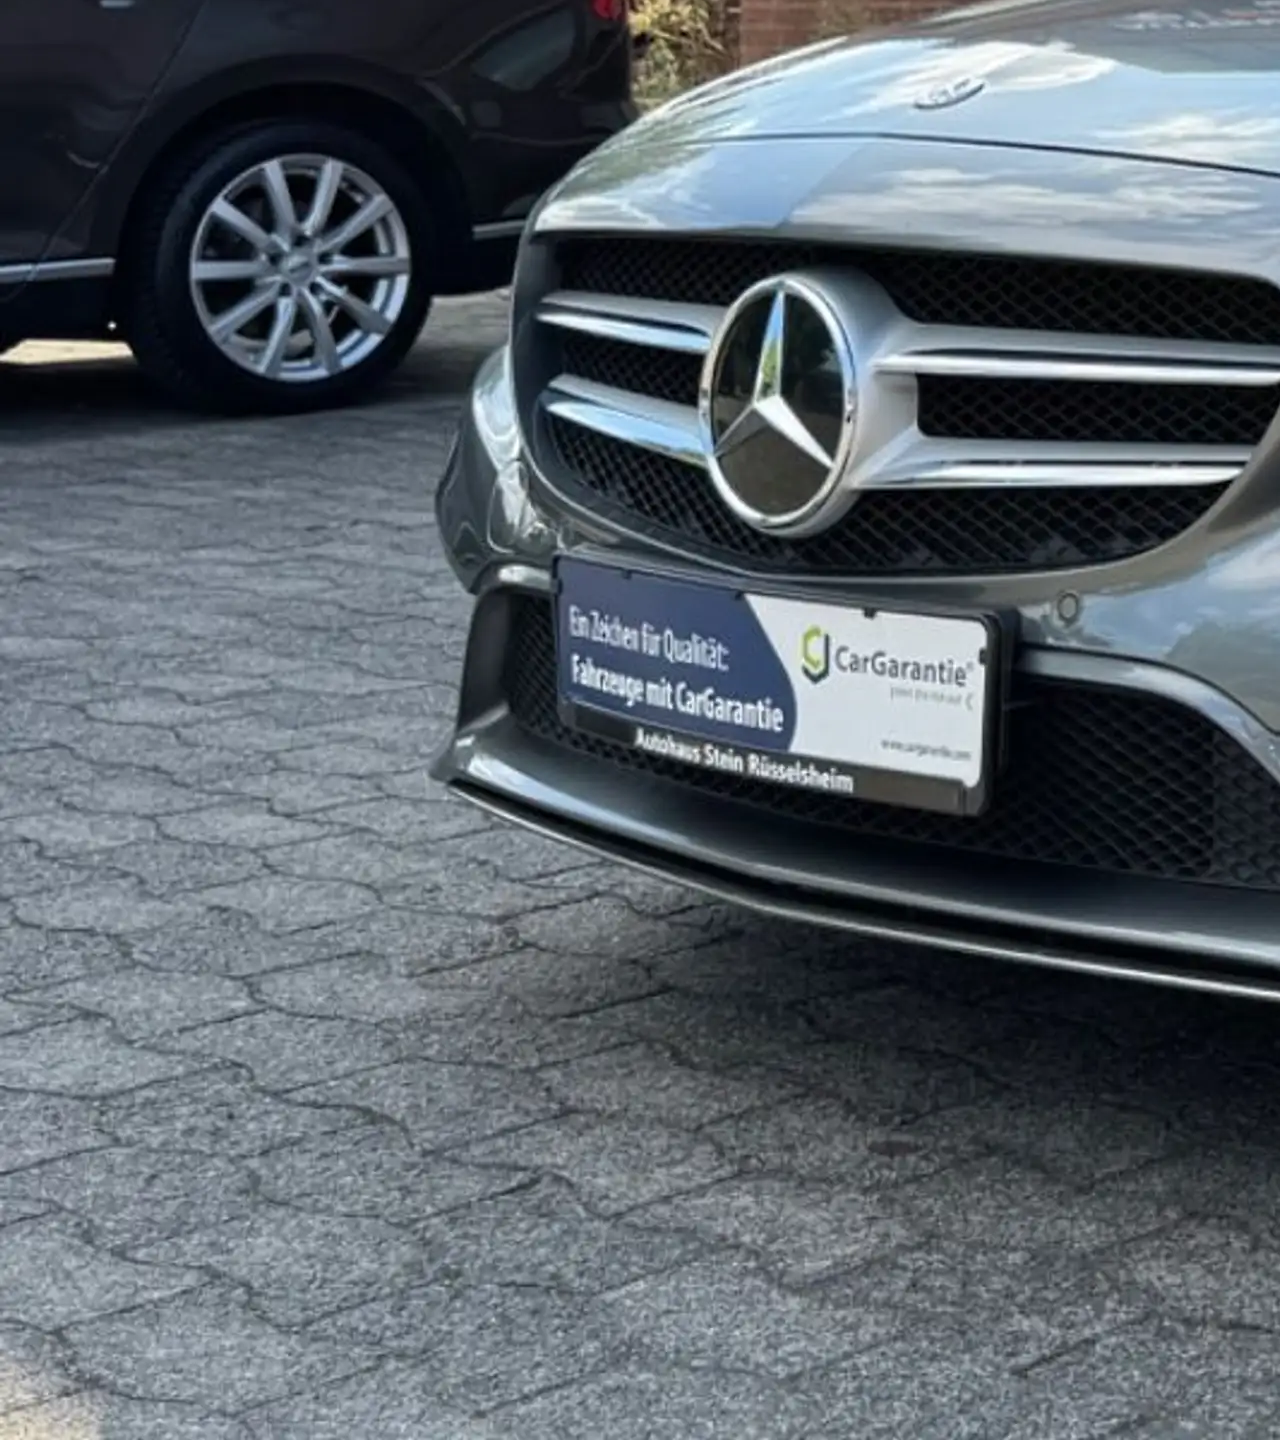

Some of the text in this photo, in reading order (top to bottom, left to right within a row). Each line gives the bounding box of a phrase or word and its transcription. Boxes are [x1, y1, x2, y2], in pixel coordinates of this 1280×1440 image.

[568, 604, 731, 672] Ein Zeichen für Qualität:
[571, 653, 785, 733] Fahrzeuge mit CarGarantie
[634, 727, 854, 794] Autohaus Stein Rüsselsheim
